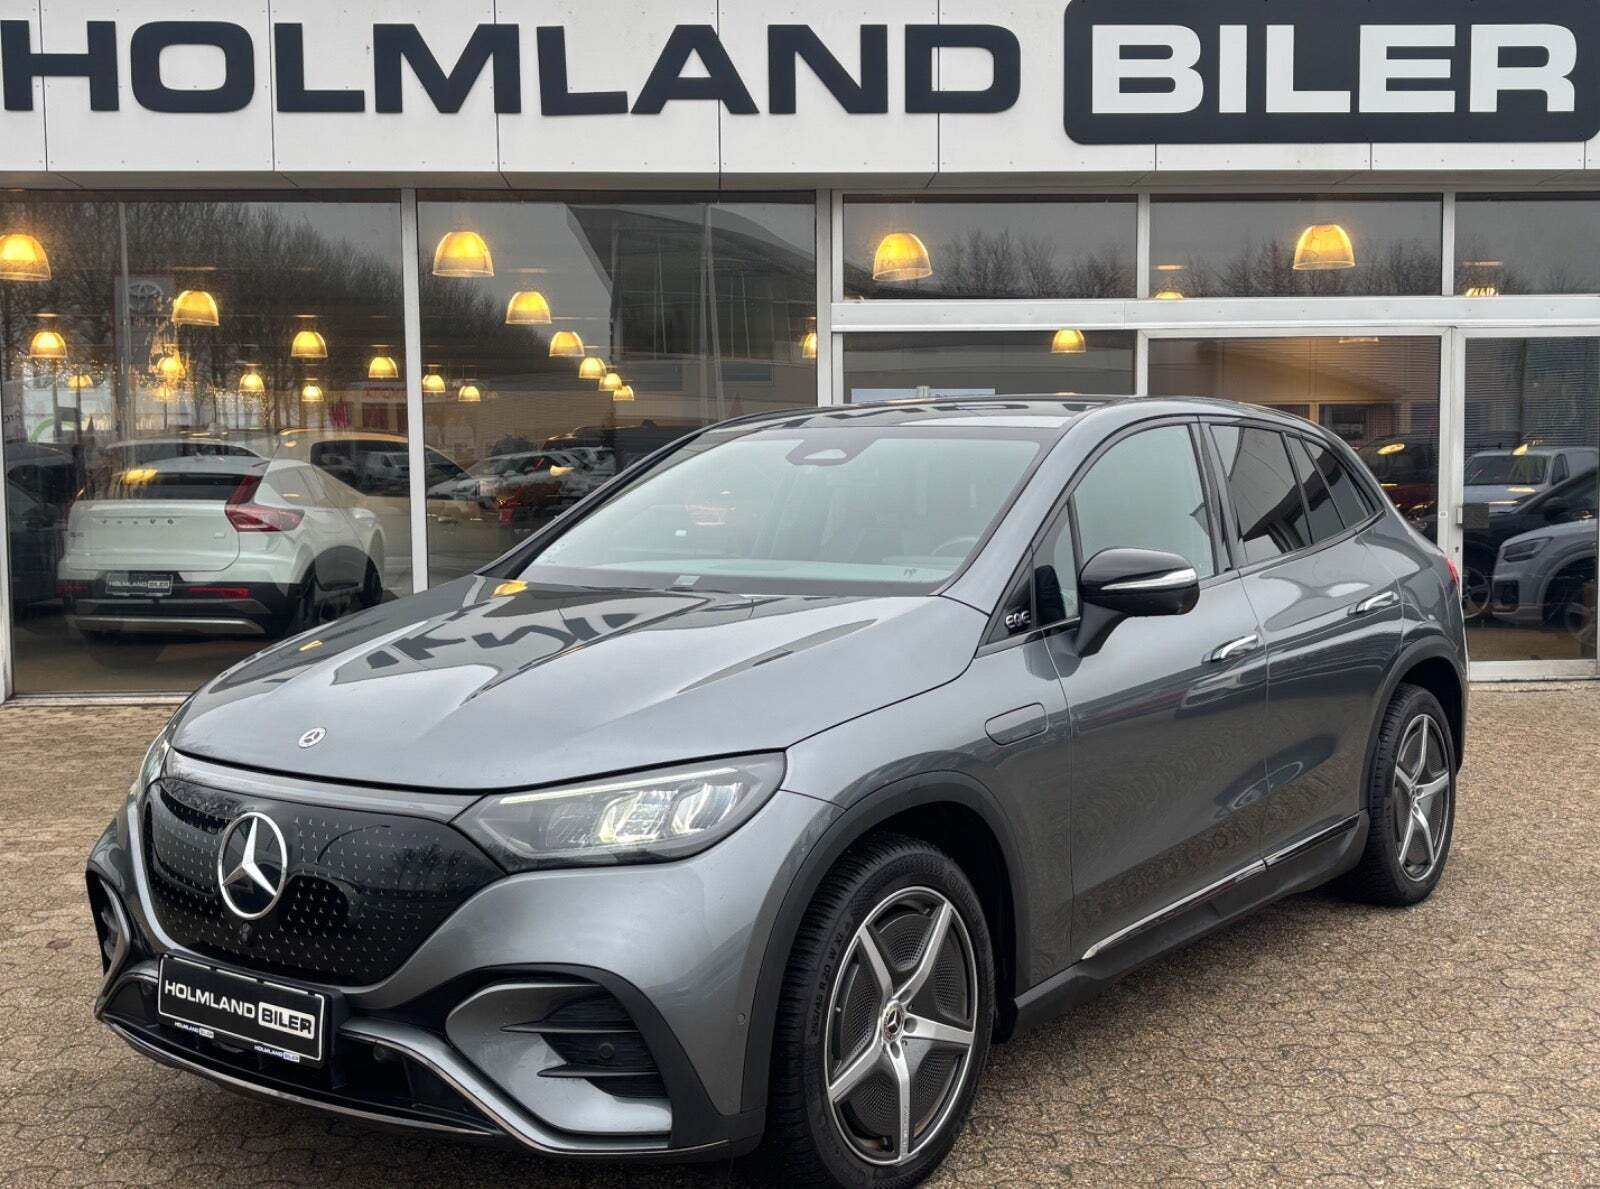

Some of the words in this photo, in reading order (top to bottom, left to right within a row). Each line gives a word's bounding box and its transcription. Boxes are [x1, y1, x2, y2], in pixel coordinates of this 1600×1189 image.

[0, 20, 1021, 116] HOLMLAND
[1092, 23, 1578, 114] BILER
[164, 979, 256, 1019] HOLMLAND
[261, 1006, 312, 1035] BILER
